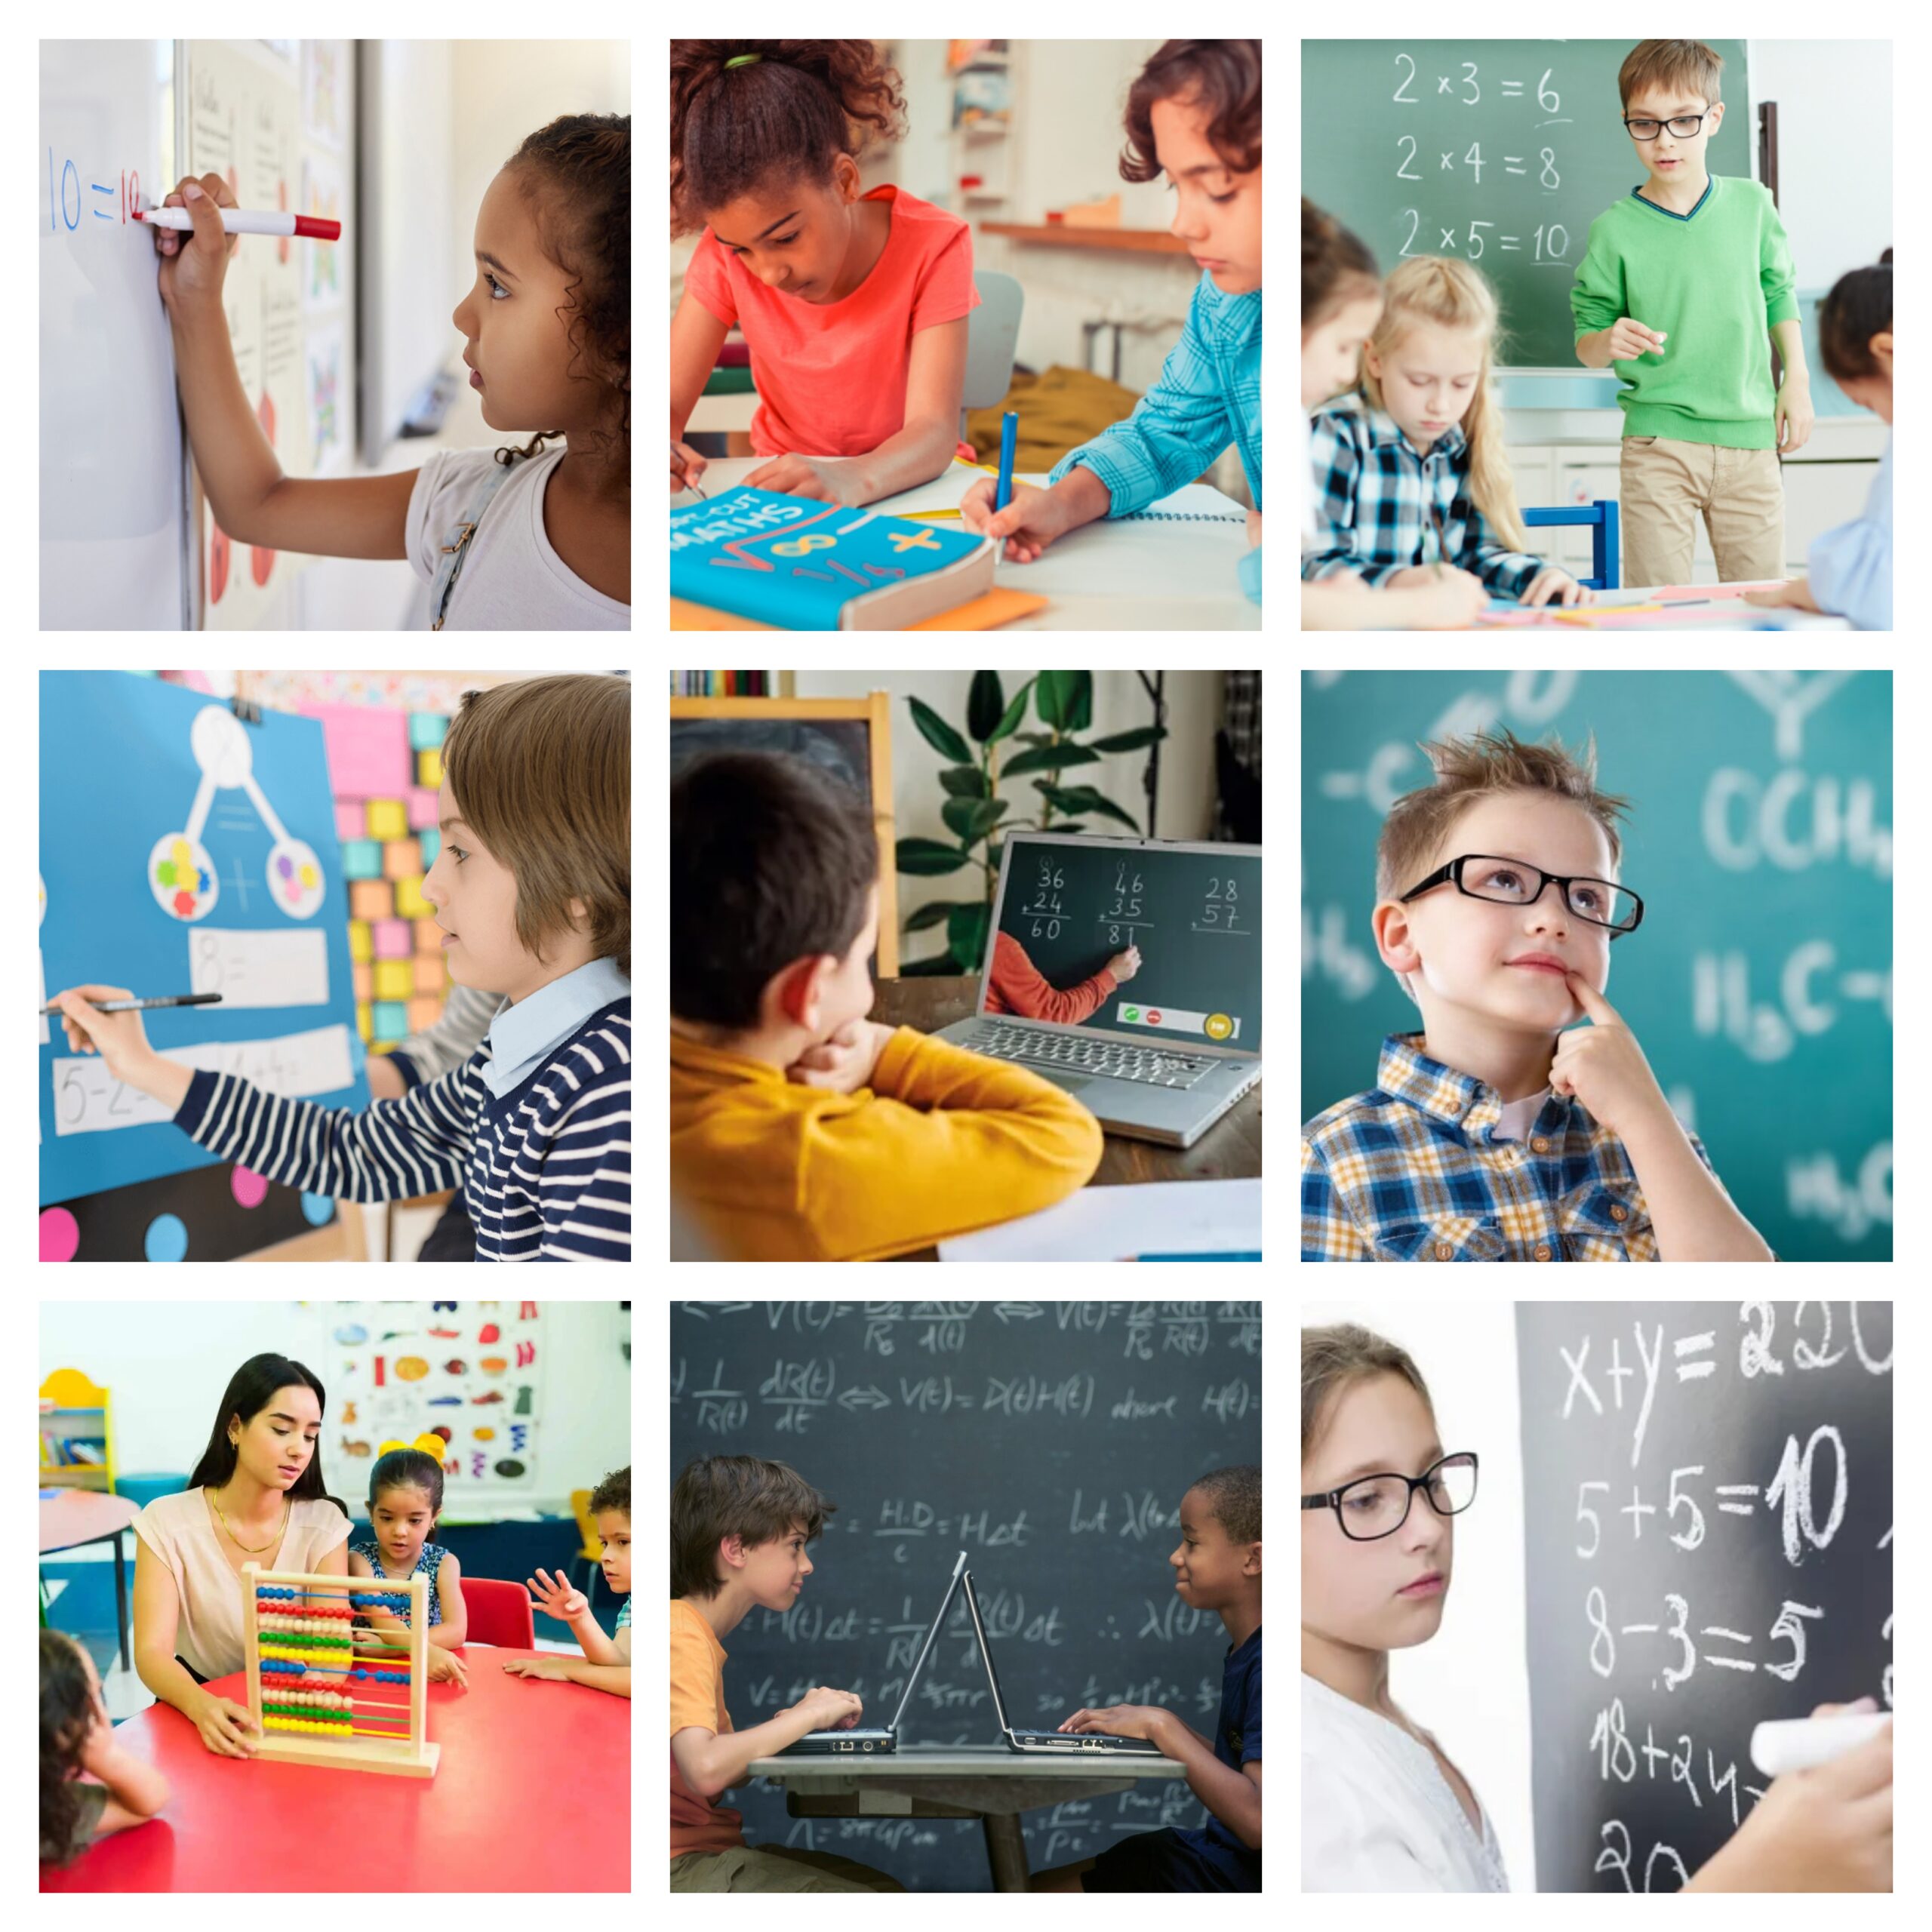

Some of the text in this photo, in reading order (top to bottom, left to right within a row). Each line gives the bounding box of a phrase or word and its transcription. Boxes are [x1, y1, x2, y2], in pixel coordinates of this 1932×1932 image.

[1393, 53, 1420, 103] 2
[1461, 62, 1481, 105] 3
[1501, 80, 1524, 96] =
[1537, 68, 1560, 112] 6
[1397, 135, 1423, 180] 2
[1464, 142, 1487, 184] 4
[1504, 156, 1527, 174] =
[1540, 147, 1560, 189] 8
[48, 146, 81, 232] 10
[1399, 208, 1423, 257] 2
[1468, 220, 1494, 259] 5
[1500, 235, 1521, 250] =
[1534, 224, 1571, 261] 10
[670, 503, 804, 552] MATHS
[1038, 868, 1064, 889] 36
[1115, 873, 1144, 896] 46
[1205, 878, 1238, 902] 28
[1034, 891, 1061, 915] 24
[1109, 898, 1143, 917] 35
[1031, 918, 1060, 940] 60
[1201, 904, 1240, 929] 57
[1109, 924, 1134, 949] 81
